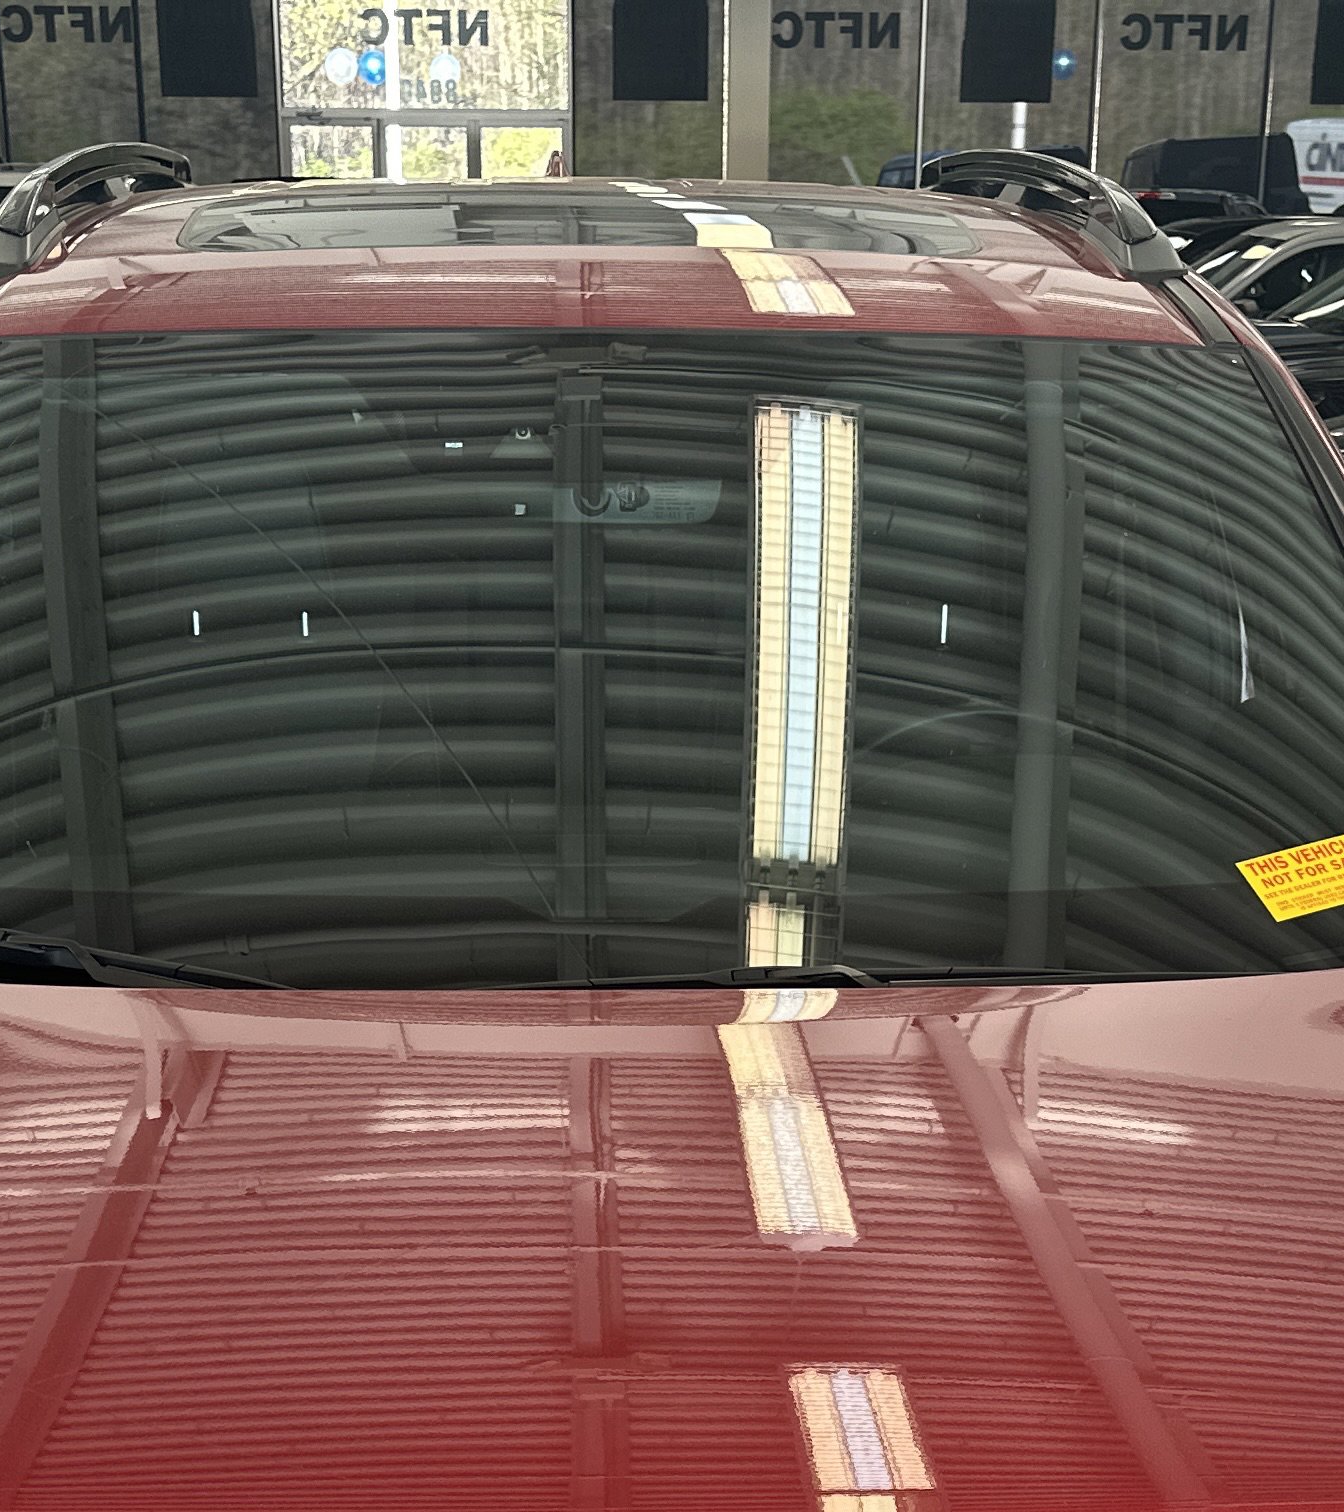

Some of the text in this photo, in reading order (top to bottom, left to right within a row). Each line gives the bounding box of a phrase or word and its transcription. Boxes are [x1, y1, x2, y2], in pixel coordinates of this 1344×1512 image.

[1245, 856, 1290, 876] THIS
[1261, 872, 1295, 888] NOT
[1295, 863, 1329, 879] FOR
[1293, 880, 1322, 891] DEALER
[1321, 876, 1337, 884] FOR
